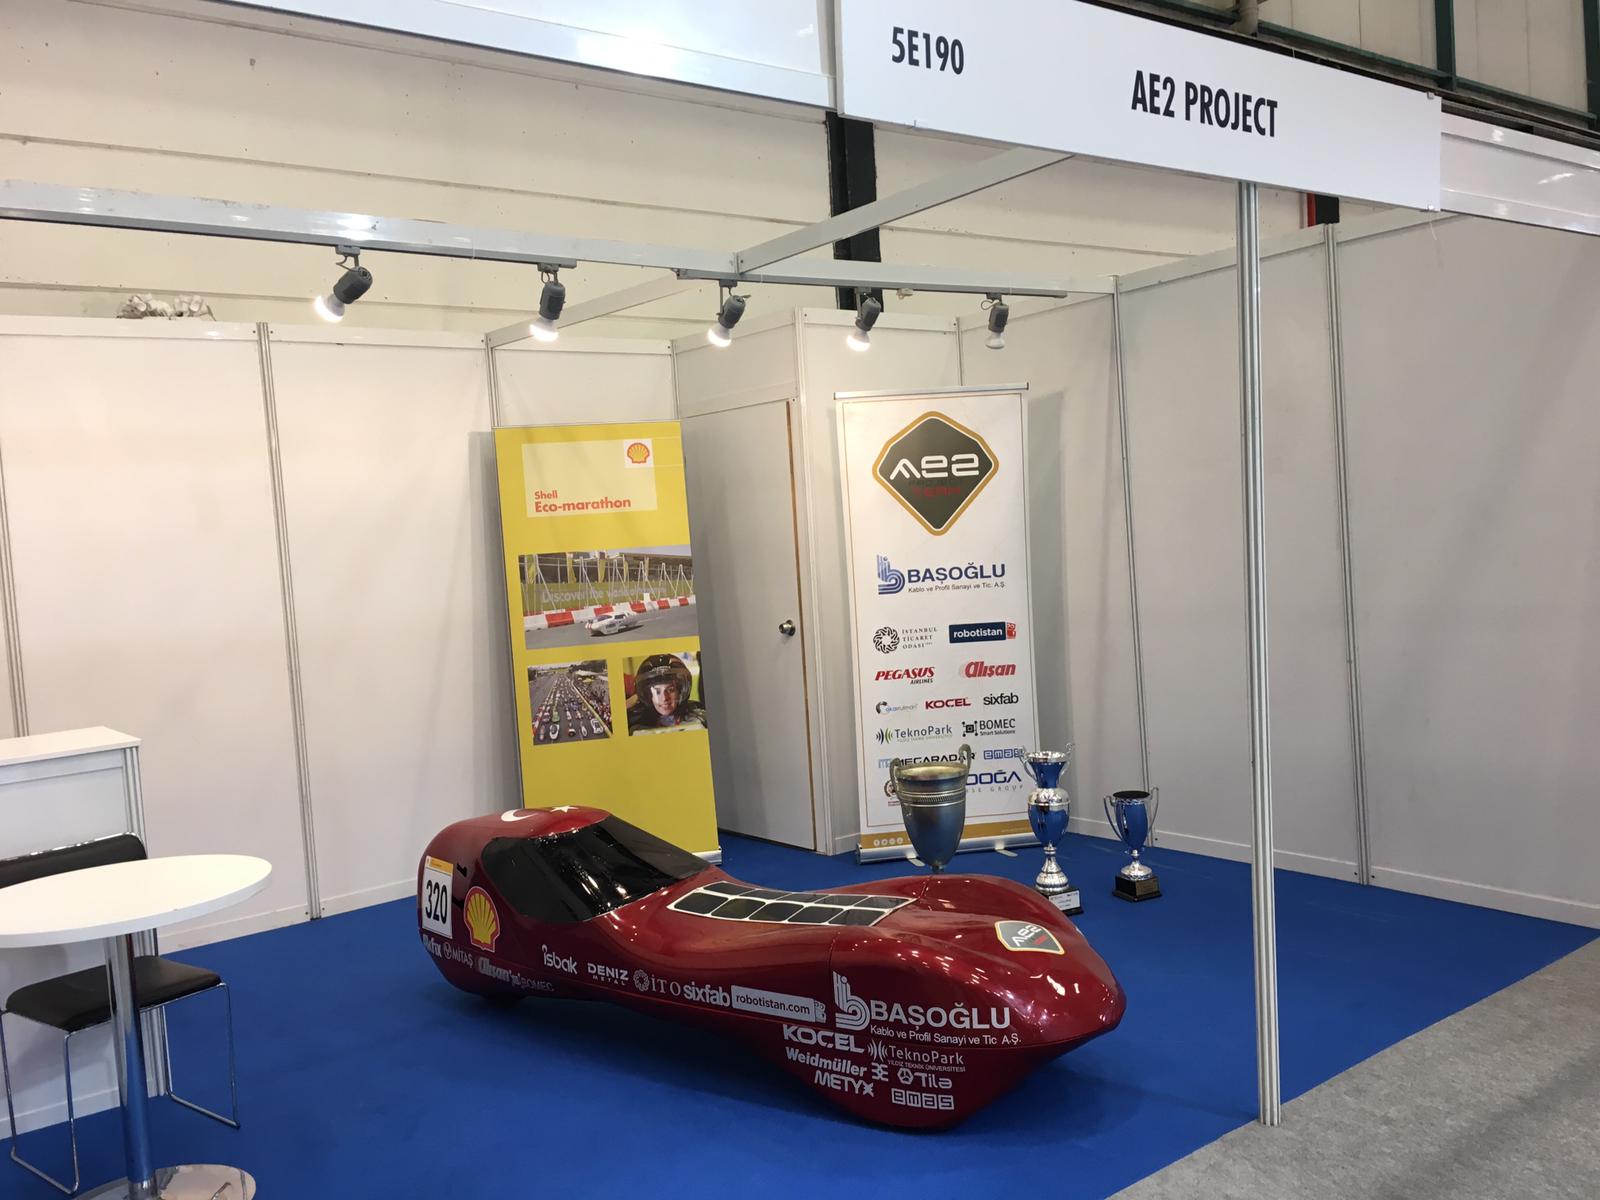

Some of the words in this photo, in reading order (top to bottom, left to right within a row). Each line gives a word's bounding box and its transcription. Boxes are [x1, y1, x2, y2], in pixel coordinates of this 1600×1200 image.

[891, 26, 964, 75] 5E190
[1131, 70, 1175, 118] AE2
[1185, 80, 1278, 138] PROJECT
[534, 490, 558, 500] Shell
[535, 496, 631, 513] Eco-marathon
[907, 562, 1006, 585] BAŞOĞLU
[953, 628, 1003, 638] robotistan
[875, 666, 935, 681] PEGASUS
[983, 692, 1019, 706] sixfab
[894, 724, 953, 739] TeknoPark
[979, 718, 1016, 730] BOMEC
[425, 879, 448, 924] 320
[587, 962, 629, 981] DENIZ
[593, 975, 625, 986] METAL
[683, 981, 730, 1007] sixfab
[735, 993, 810, 1015] robotistan.com
[870, 1000, 1011, 1030] BAŞOĞLU
[870, 1025, 894, 1037] Kablo
[909, 1030, 931, 1042] Profil
[933, 1034, 966, 1046] Sanayi
[968, 1037, 980, 1045] ve
[785, 1046, 867, 1077] Weidmüller
[888, 1045, 964, 1065] TeknoPark
[814, 1070, 874, 1097] METYX
